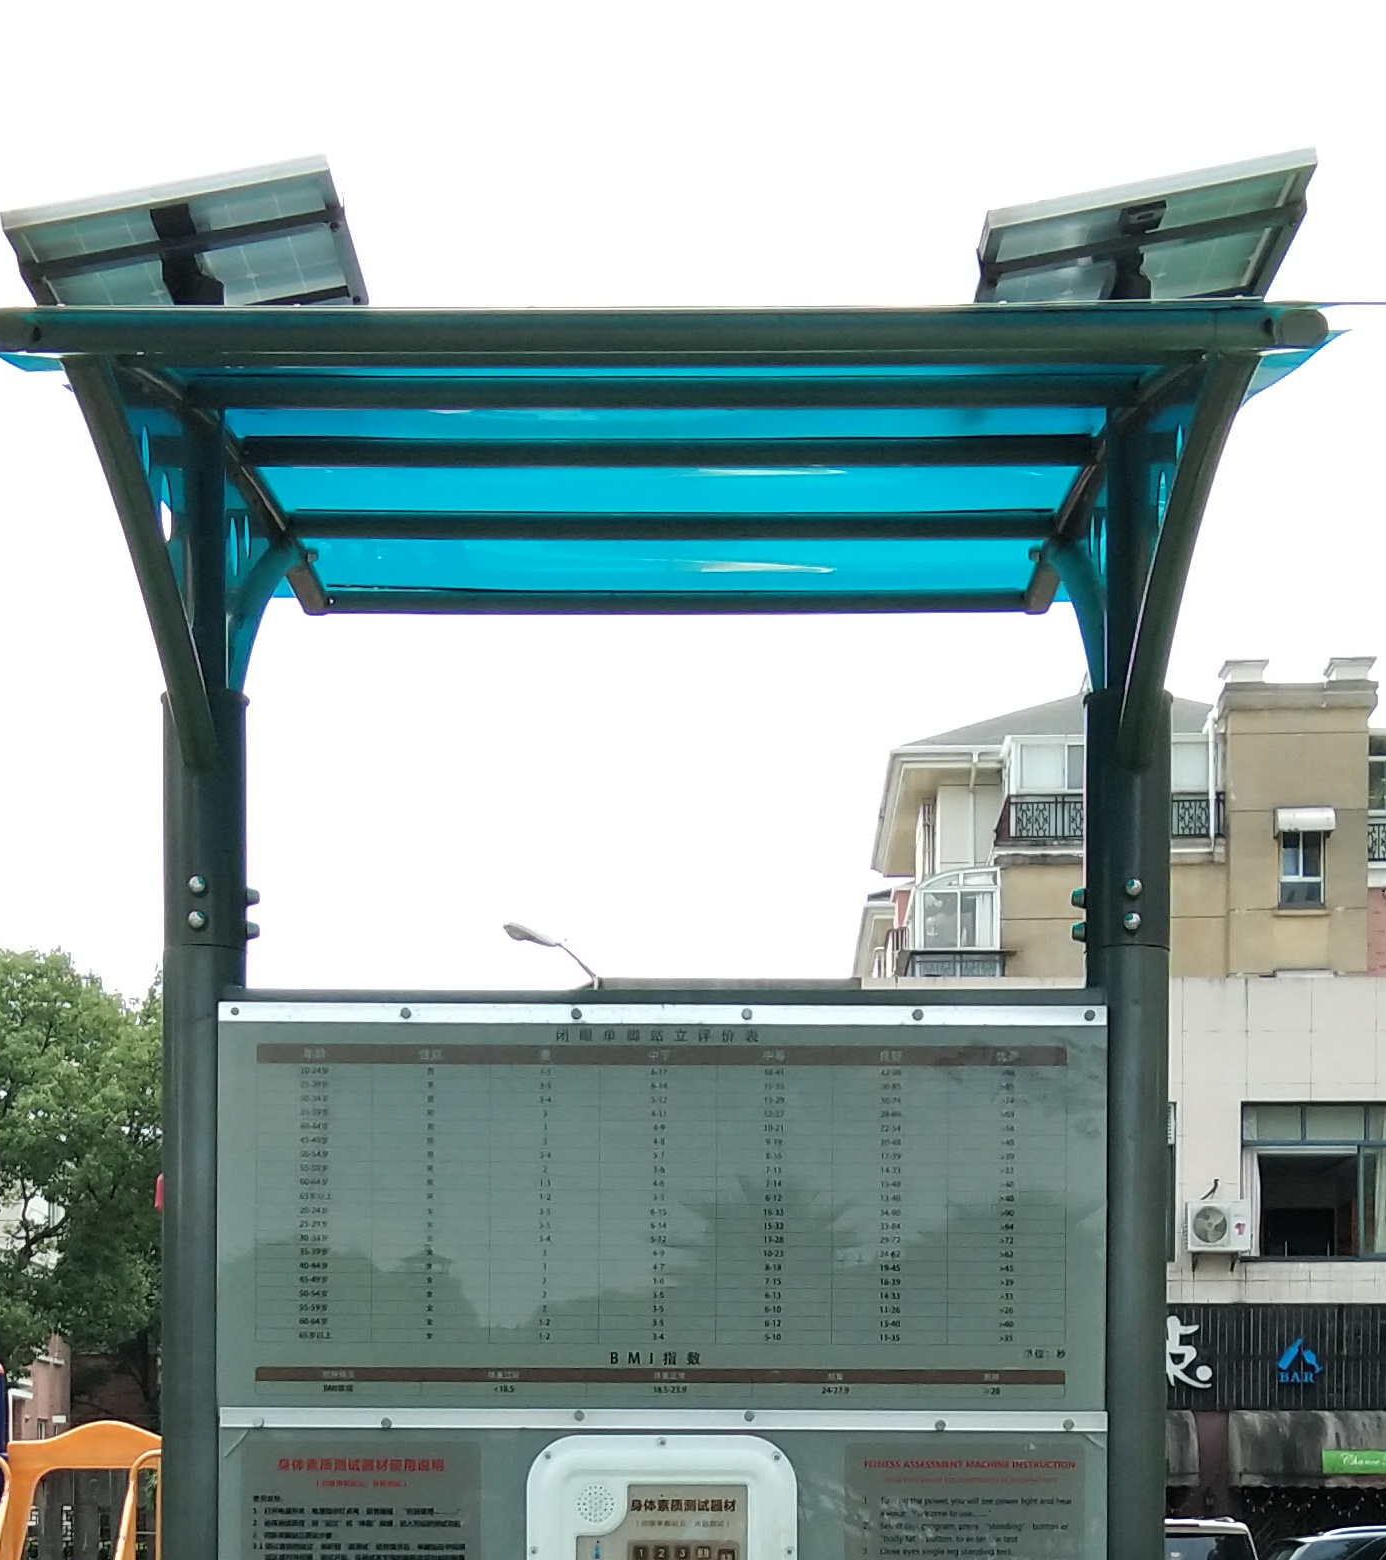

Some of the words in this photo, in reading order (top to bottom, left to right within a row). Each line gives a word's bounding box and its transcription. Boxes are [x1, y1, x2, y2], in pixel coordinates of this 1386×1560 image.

[556, 1028, 760, 1043] 闭眼单脚站立评价表
[1279, 1371, 1316, 1384] BAR
[630, 1498, 737, 1512] 身体素质测试器材
